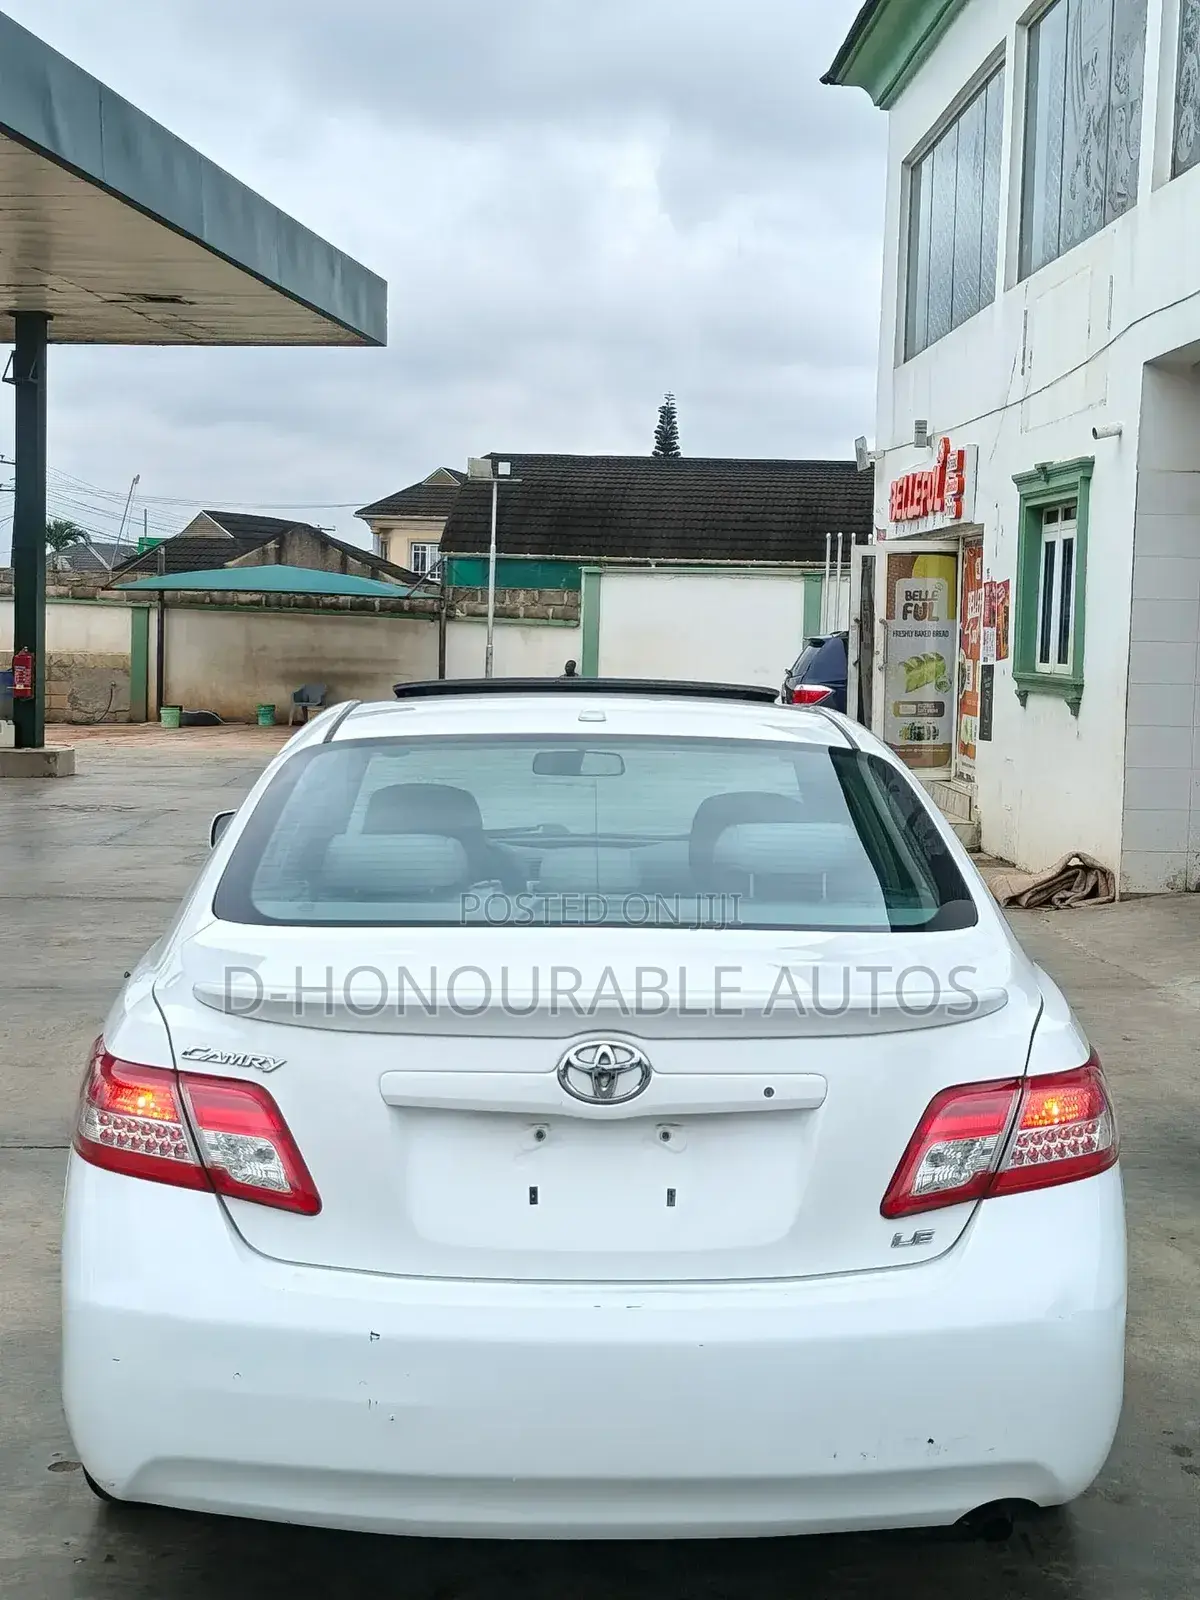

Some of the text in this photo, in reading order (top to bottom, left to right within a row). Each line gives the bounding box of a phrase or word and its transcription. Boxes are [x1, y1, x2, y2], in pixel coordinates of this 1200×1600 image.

[904, 590, 939, 601] BELLE
[902, 602, 940, 621] FUL
[892, 630, 950, 638] FRESHLY BAKED BREAD
[181, 1045, 288, 1073] CAMRY
[891, 1228, 936, 1248] LE
